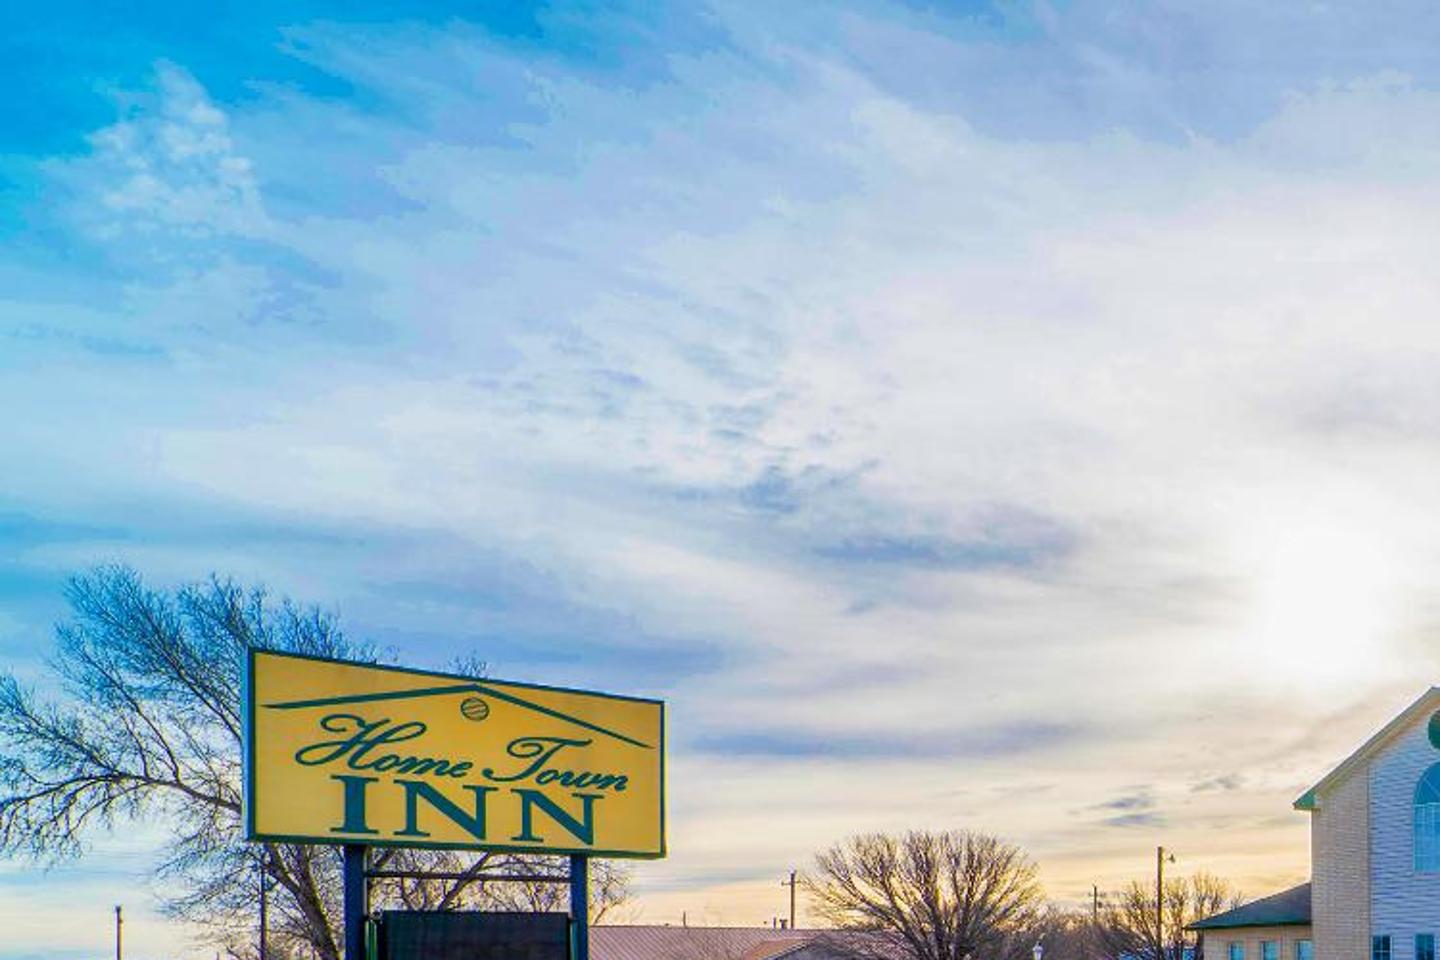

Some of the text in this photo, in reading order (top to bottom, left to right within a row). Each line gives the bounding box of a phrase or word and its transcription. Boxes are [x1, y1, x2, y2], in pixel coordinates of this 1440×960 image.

[295, 713, 629, 793] Home Town
[329, 774, 605, 846] INN
